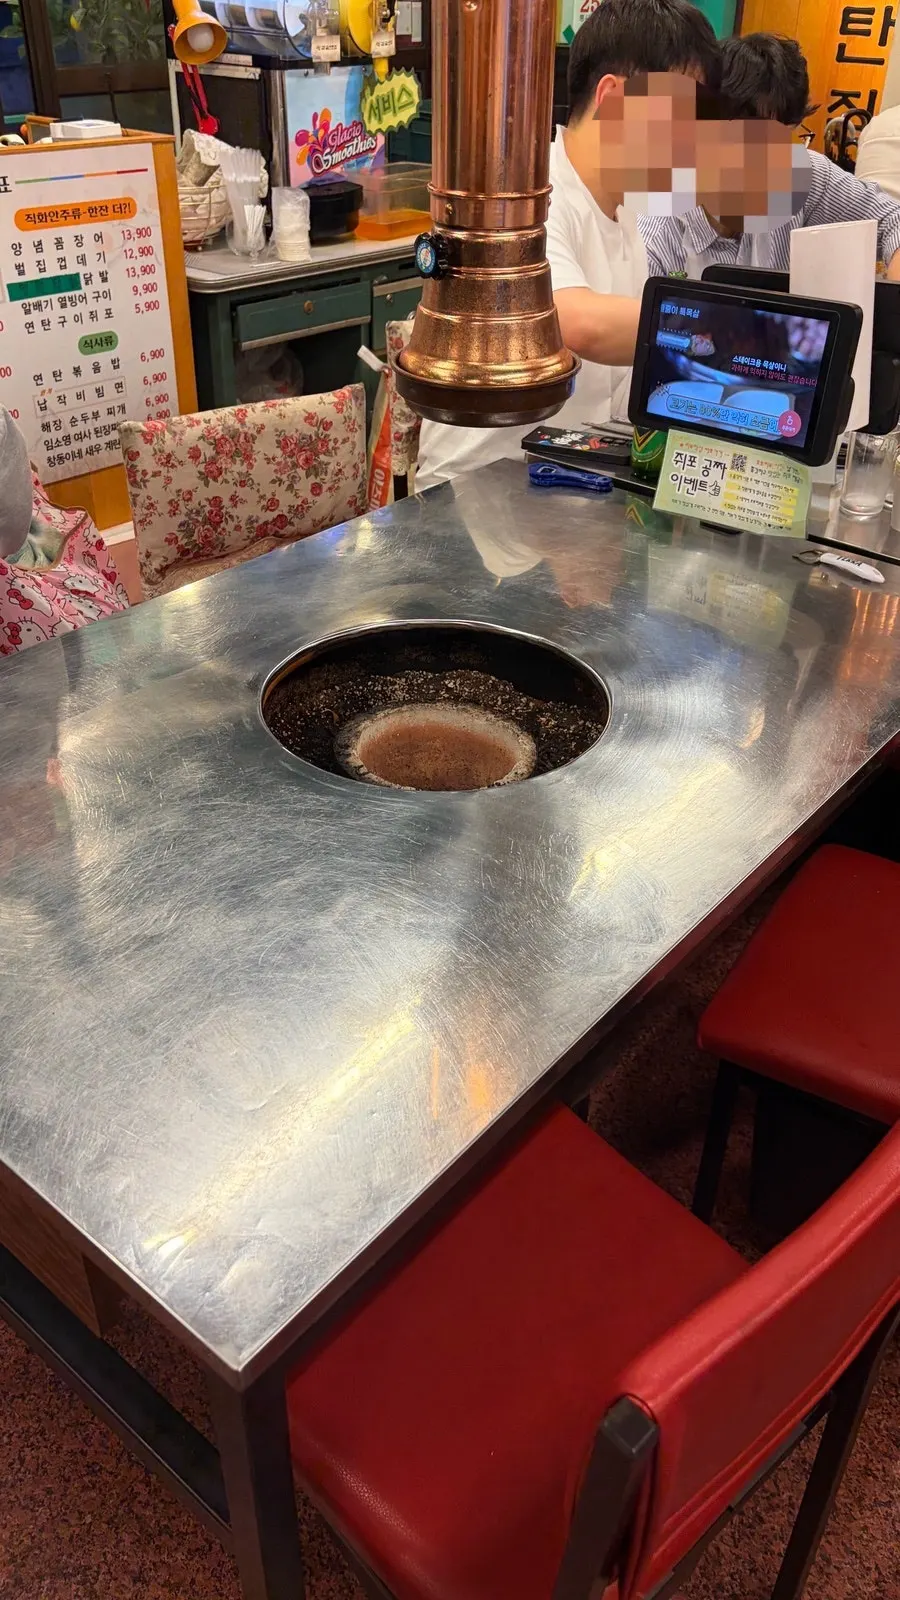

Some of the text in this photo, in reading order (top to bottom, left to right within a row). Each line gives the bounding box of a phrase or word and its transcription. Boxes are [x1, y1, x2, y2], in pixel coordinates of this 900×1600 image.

[367, 84, 415, 124] 서비스
[312, 136, 377, 173] Smoothies
[25, 202, 131, 224] 직화안주류-한잔 더?!
[121, 227, 152, 241] 13,900
[123, 245, 154, 260] 12,900
[126, 264, 156, 279] 13,900
[21, 282, 158, 316] 알배기 열빙어 구이 9,900
[135, 300, 160, 314] 5,900
[83, 335, 113, 349] 식사류
[140, 348, 165, 363] 6,900
[732, 355, 787, 373] 스테이크용 목살이니
[143, 372, 167, 386] 6,900
[40, 393, 170, 433] 해장 순두부 찌개 6,900
[43, 435, 72, 452] 임소영
[73, 428, 92, 443] 여사
[147, 409, 171, 422] 6,900
[46, 449, 83, 468] 창동이네
[85, 444, 103, 457] 새우
[672, 451, 697, 470] 쥐포
[702, 458, 728, 480] 공짜
[670, 473, 709, 496] 이벤트
